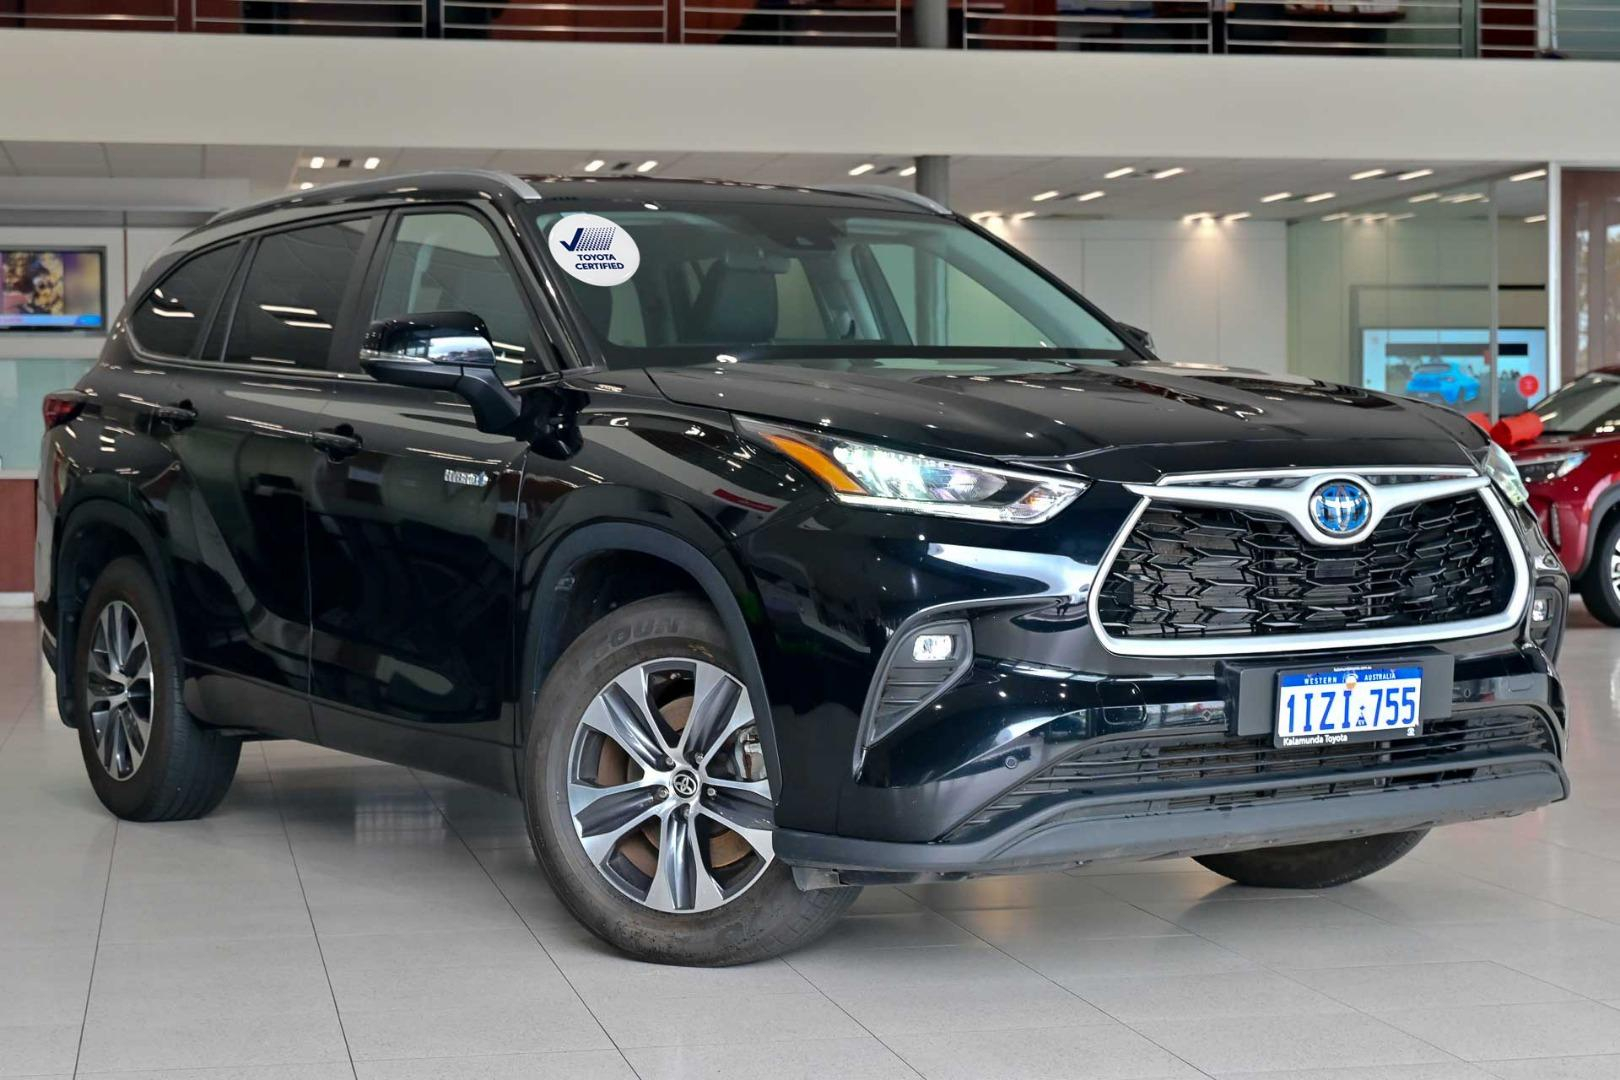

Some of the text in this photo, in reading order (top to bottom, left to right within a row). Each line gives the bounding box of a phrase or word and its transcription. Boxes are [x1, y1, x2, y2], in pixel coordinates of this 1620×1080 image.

[575, 262, 624, 270] CERTIFIED
[1304, 672, 1396, 685] WESTERN AUSTRALIA
[1370, 687, 1416, 727] 755
[1283, 733, 1348, 746] Kalamunda Toyota
